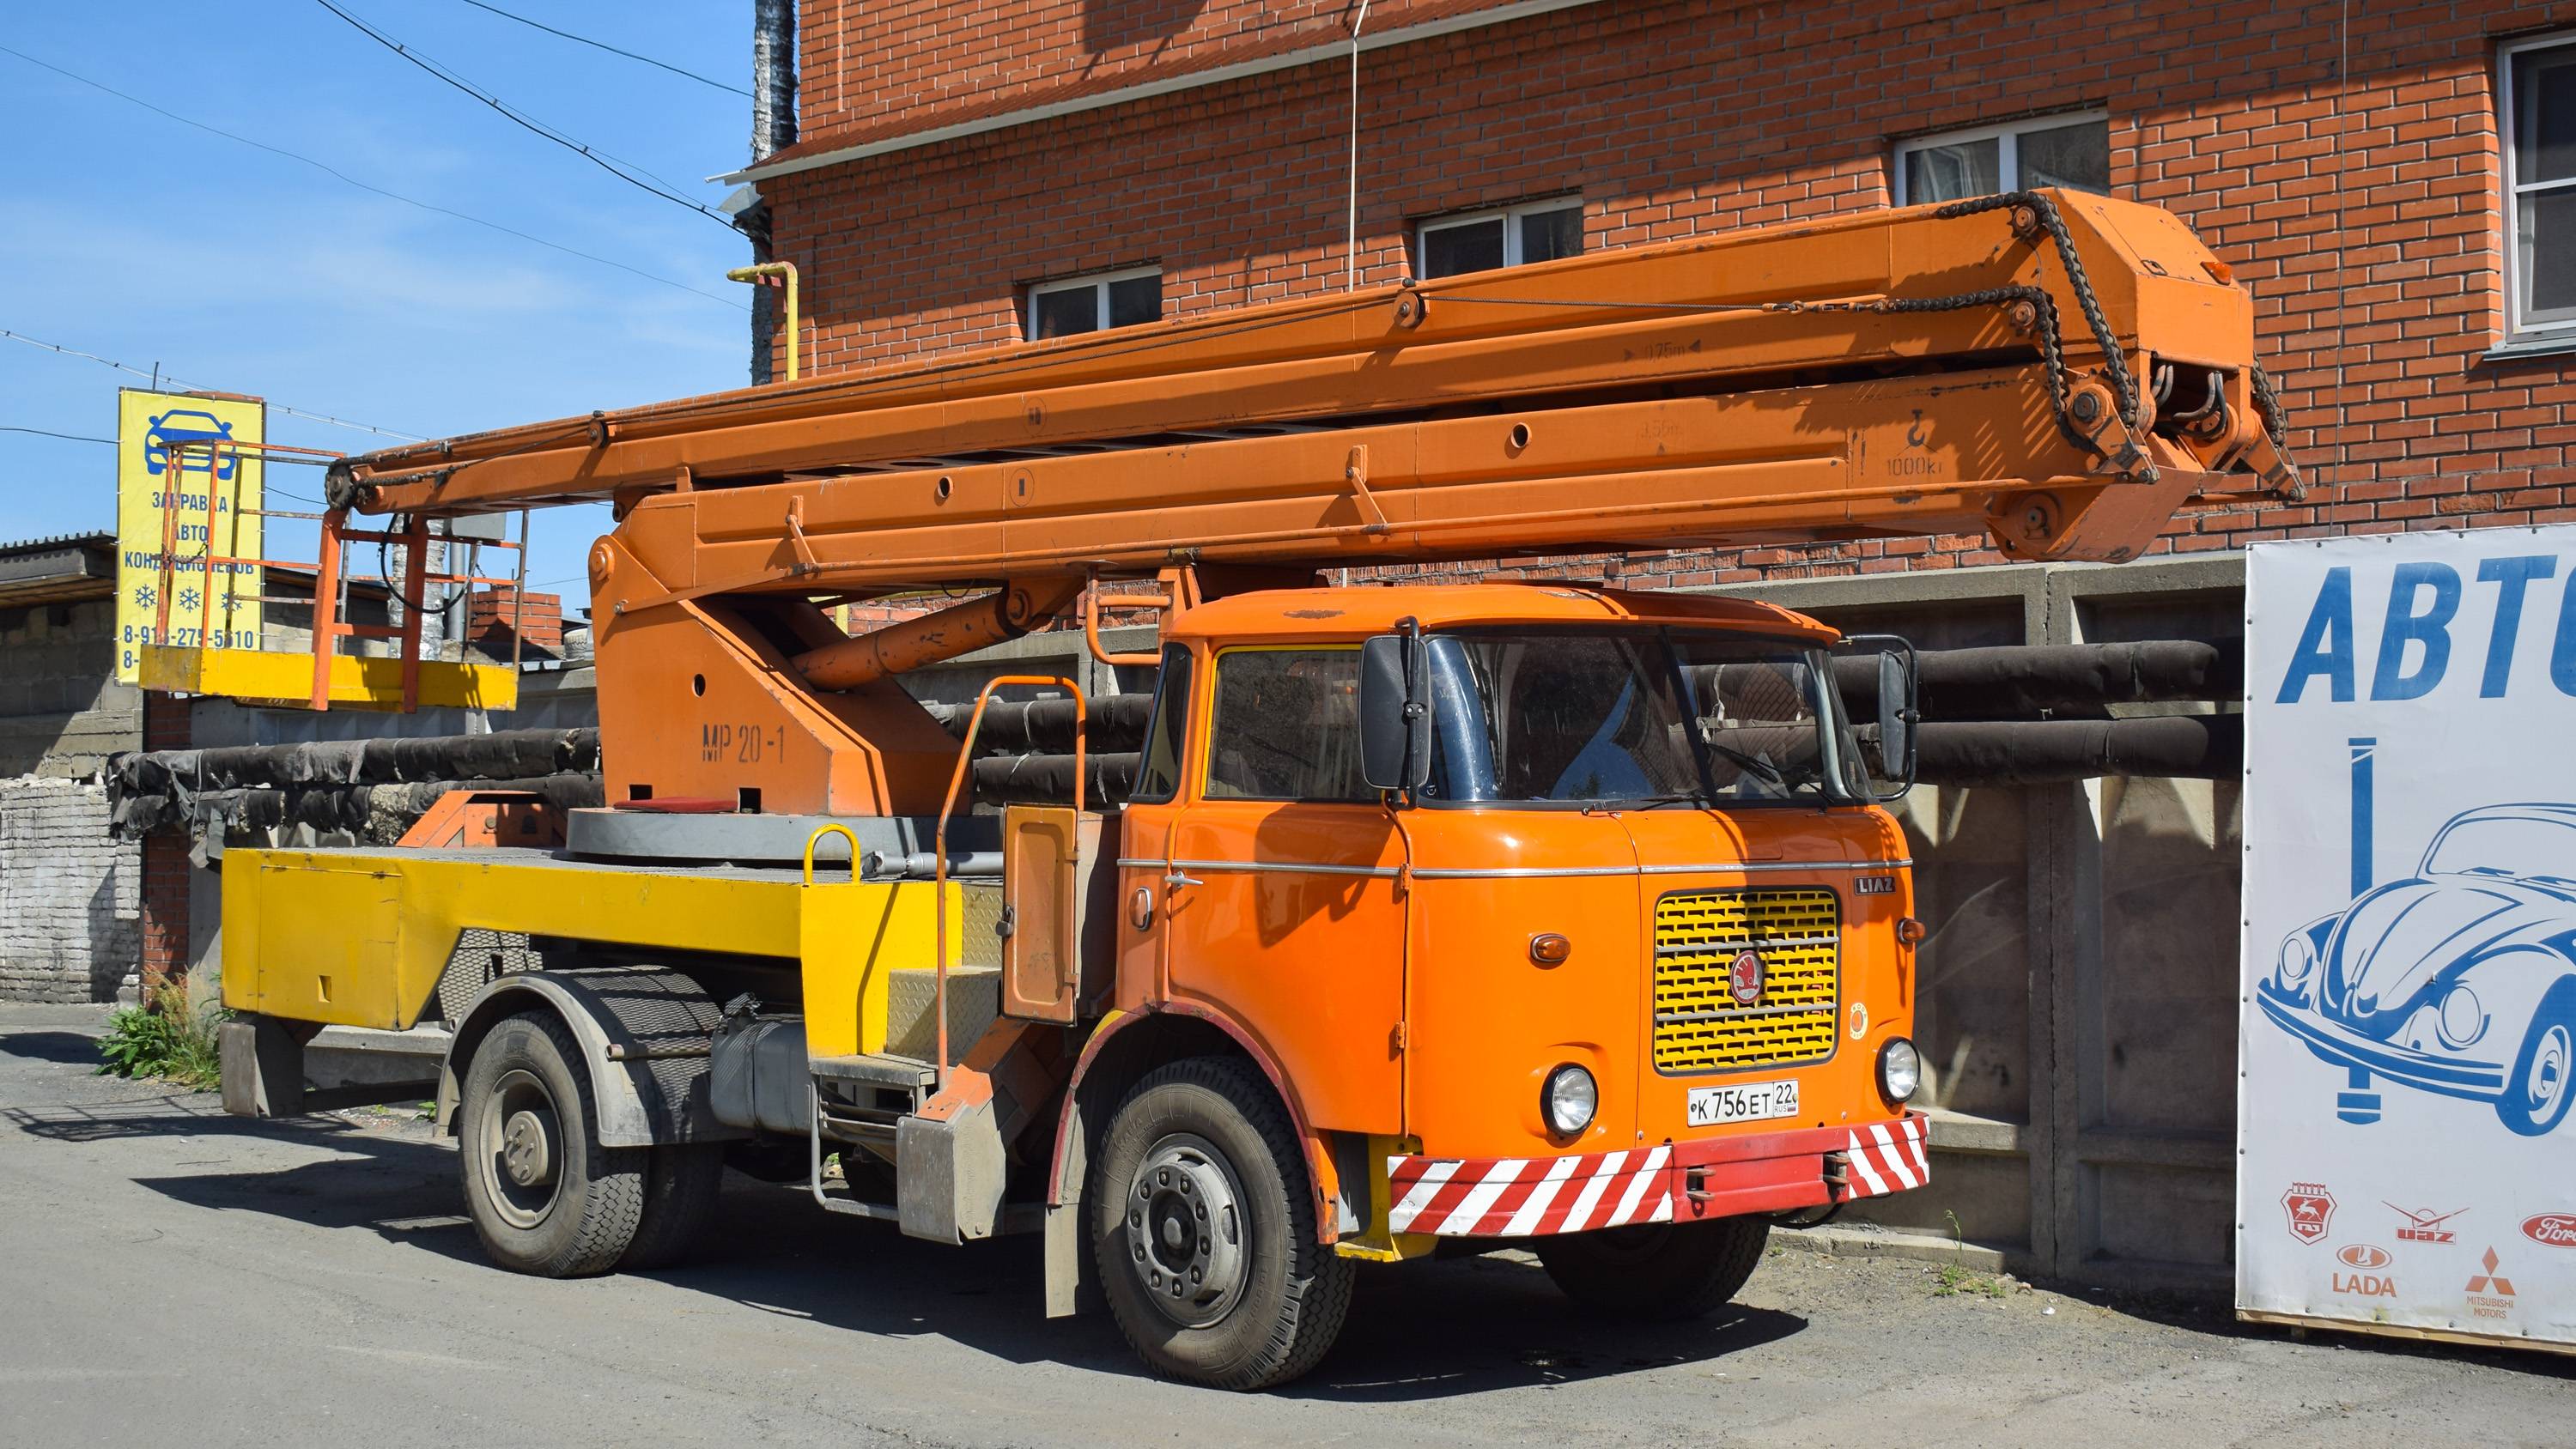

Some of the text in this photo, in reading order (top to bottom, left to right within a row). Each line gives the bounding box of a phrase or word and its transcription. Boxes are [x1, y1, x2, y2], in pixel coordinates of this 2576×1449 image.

[1859, 877, 1893, 893] LIAZ
[2536, 1217, 2576, 1242] For
[2333, 1272, 2397, 1298] LADA
[2467, 1296, 2513, 1308] MITSUBISHI
[2474, 1307, 2506, 1319] MOTORS
